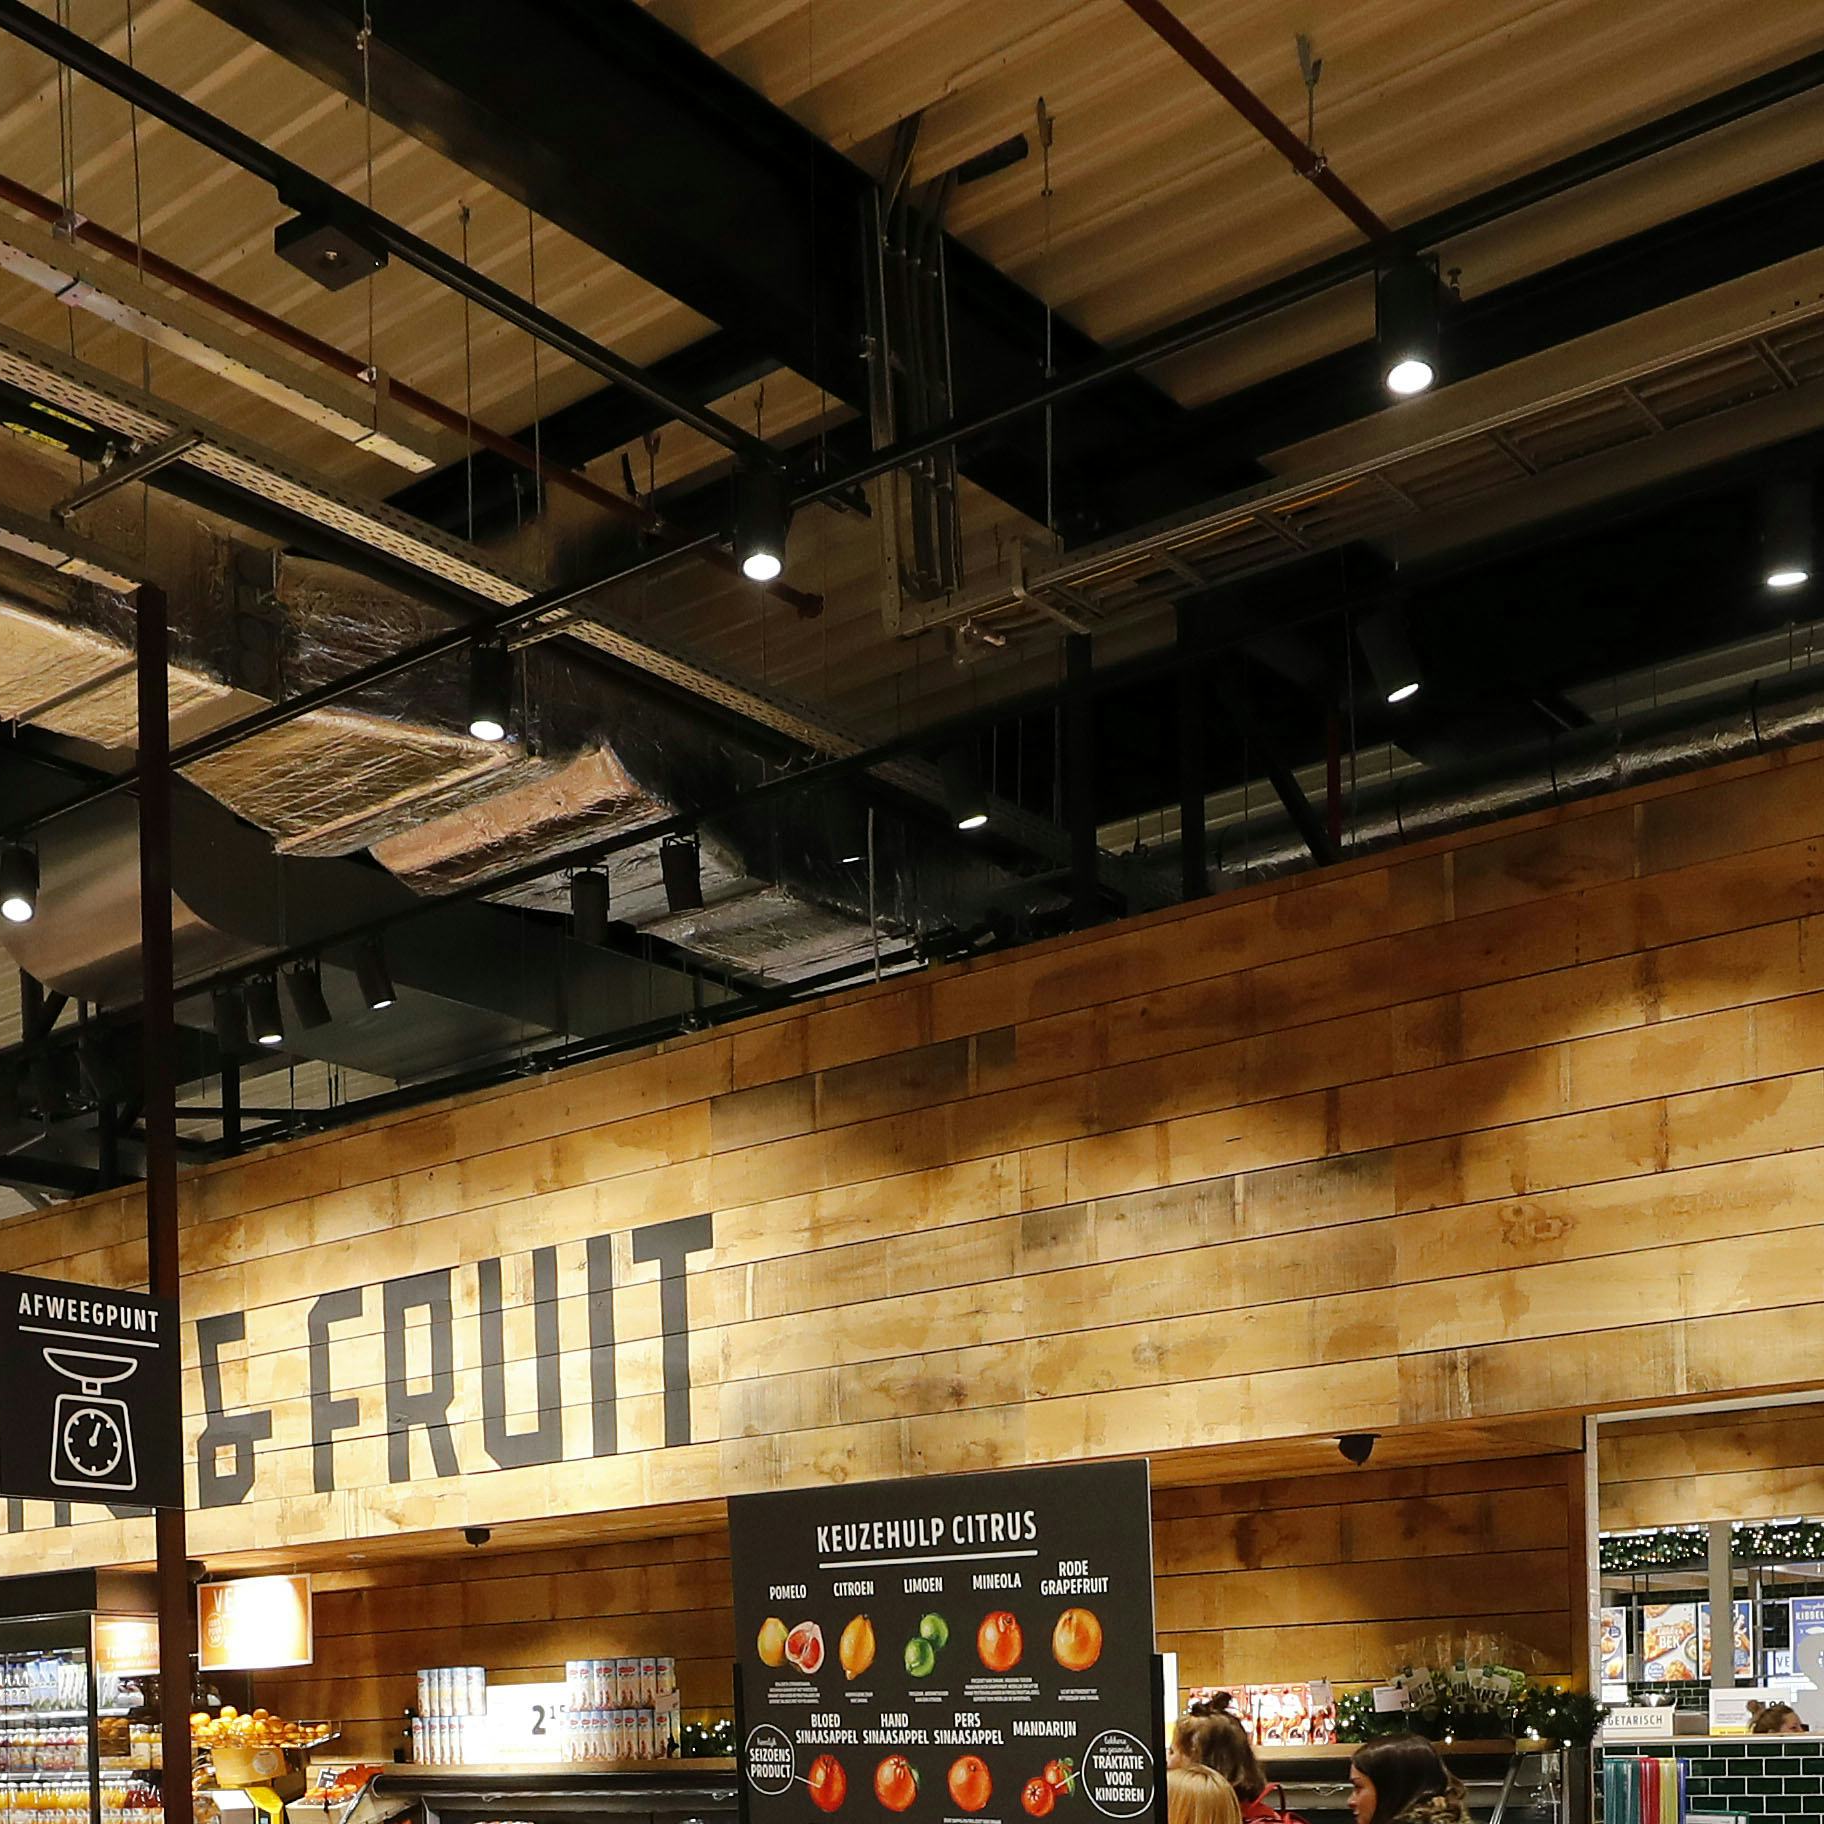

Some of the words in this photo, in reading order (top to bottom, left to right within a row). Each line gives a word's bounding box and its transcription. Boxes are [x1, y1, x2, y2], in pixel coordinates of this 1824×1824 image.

[18, 1291, 159, 1334] AFWEEGPUNT
[195, 1312, 274, 1507] &
[307, 1213, 714, 1492] FRUIT
[817, 1516, 945, 1553] KEUZEHULP
[952, 1509, 1037, 1545] CITRUS
[1058, 1560, 1089, 1578] RODE
[833, 1580, 874, 1598] CITROEN
[904, 1576, 943, 1594] LIMOEN
[972, 1572, 1022, 1591] MINEOLA
[1040, 1576, 1109, 1597] GRAPEFRUIT
[769, 1584, 807, 1601] POMELO
[810, 1713, 841, 1728] BLOED
[880, 1713, 909, 1728] HAND
[954, 1712, 981, 1727] PERS
[1602, 1714, 1663, 1727] EGETARISCH
[795, 1729, 859, 1745] SINAASAPPEL
[863, 1729, 929, 1745] SINAASAPPEL
[934, 1729, 1004, 1745] SINAASAPPEL
[1012, 1720, 1077, 1738] MANDARIJN
[749, 1748, 791, 1763] SEIZOENS
[1092, 1755, 1144, 1770] TRAKTATIE
[751, 1763, 791, 1779] PRODUCT
[1104, 1771, 1133, 1786] VOOR
[1095, 1787, 1145, 1802] KINDEREN
